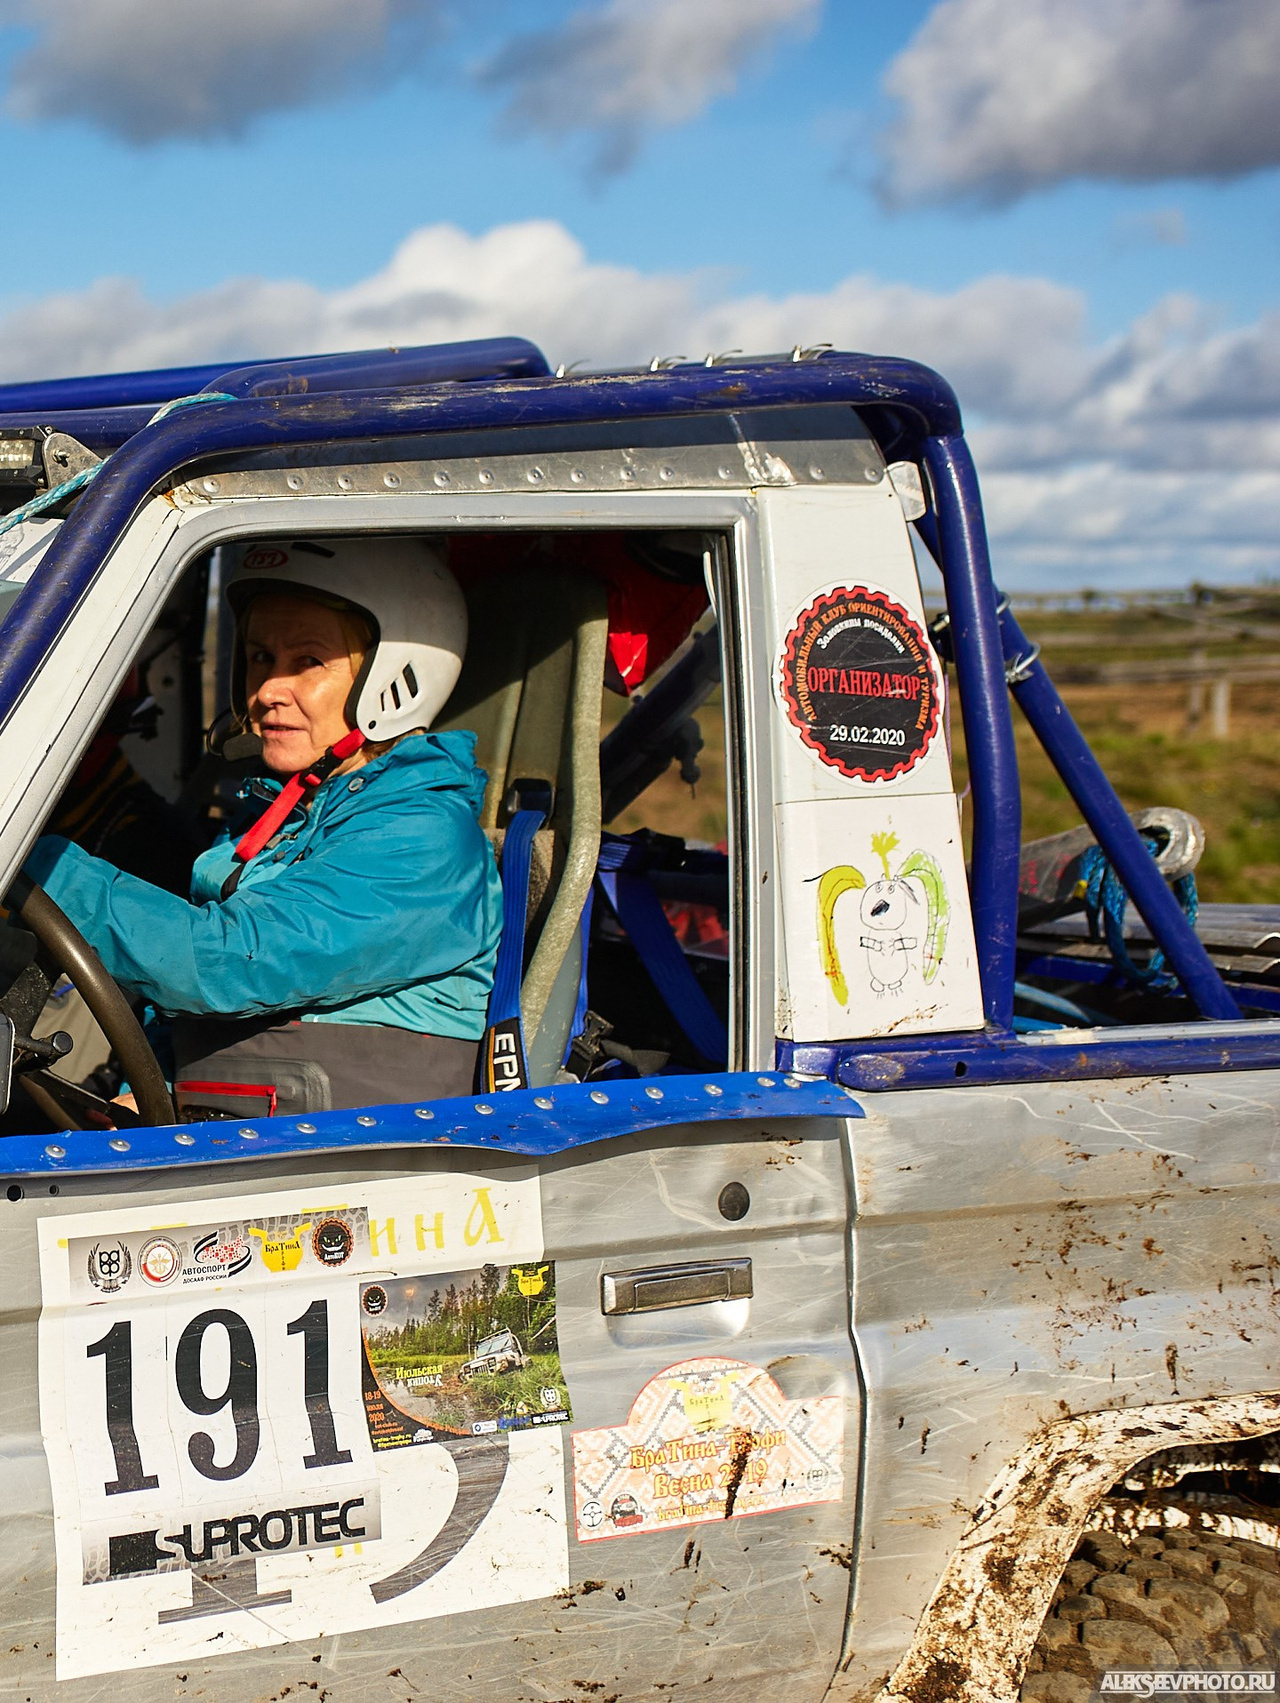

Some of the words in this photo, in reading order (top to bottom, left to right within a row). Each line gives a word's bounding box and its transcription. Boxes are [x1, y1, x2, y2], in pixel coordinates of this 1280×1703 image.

[796, 621, 823, 722] АВТОМОБИЛЬНЫЙ
[821, 603, 847, 625] КЛУБ
[914, 675, 931, 730] ТУРИЗМА
[808, 666, 921, 701] ОРГАНИЗАТОР
[829, 724, 906, 747] 29.02.2020
[182, 1264, 226, 1276] АВТОСПОРТ
[182, 1276, 205, 1285] ДОСААФ
[205, 1274, 228, 1282] РОССИИ
[396, 1364, 444, 1380] Июльская
[85, 1299, 353, 1496] 191
[653, 1472, 714, 1499] Весна
[718, 1457, 768, 1488] 219
[153, 1496, 366, 1565] SUPROTEC
